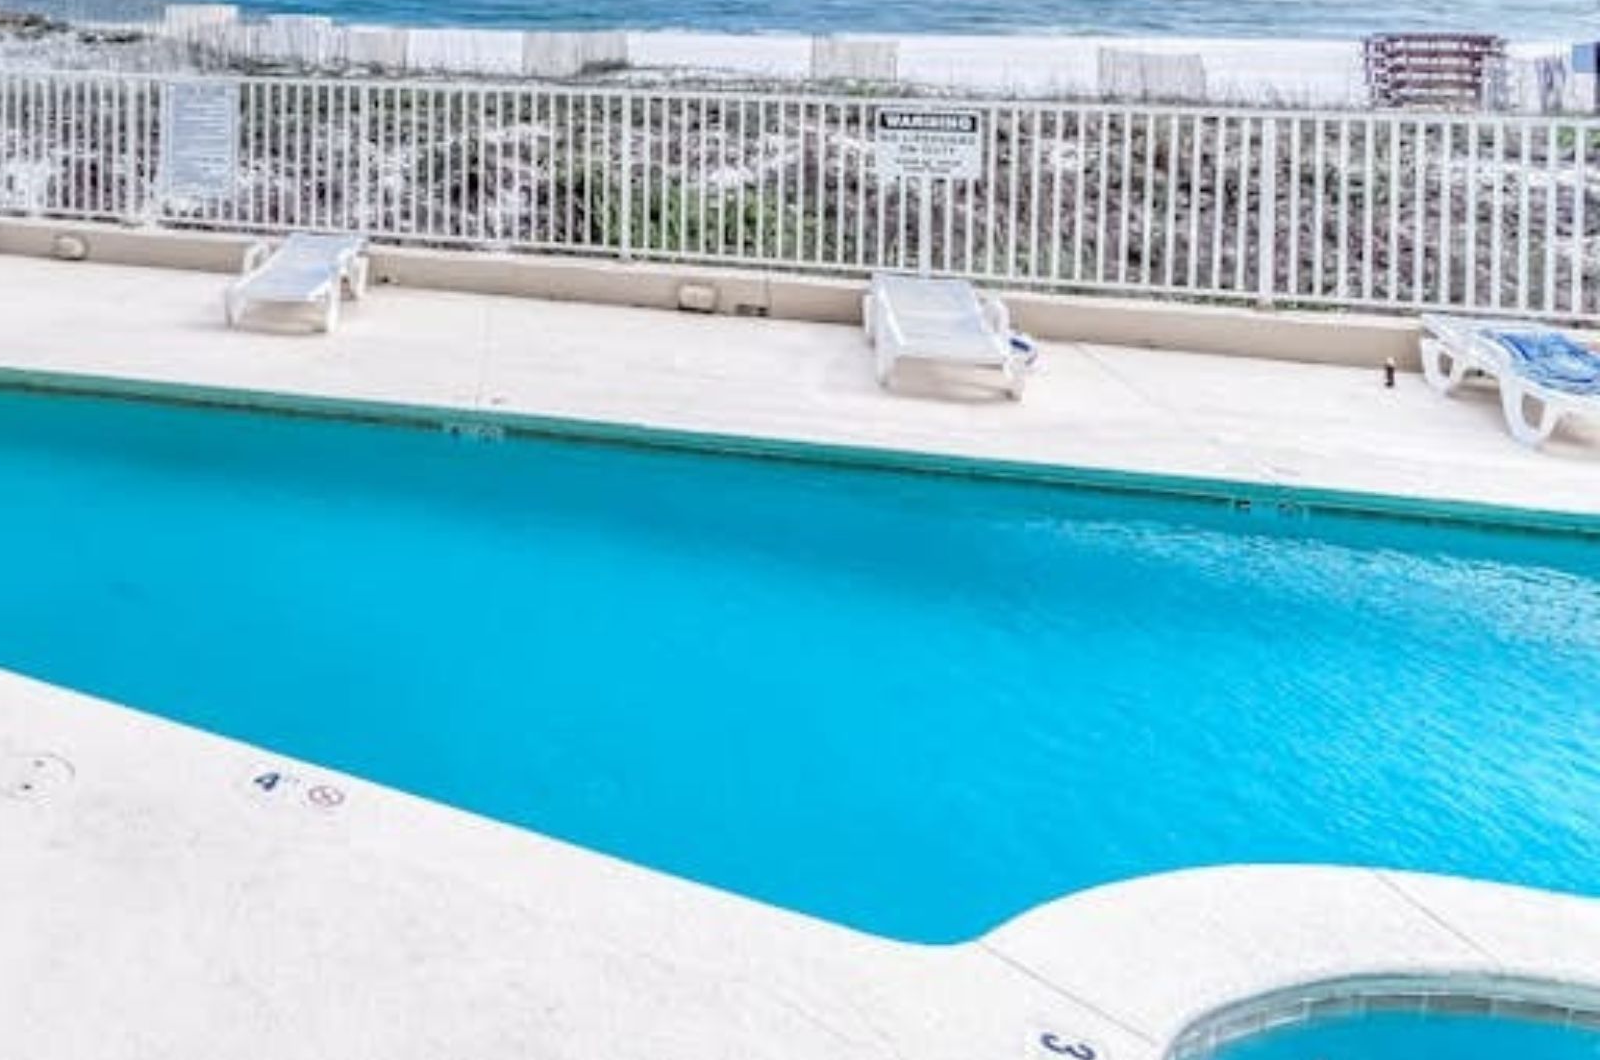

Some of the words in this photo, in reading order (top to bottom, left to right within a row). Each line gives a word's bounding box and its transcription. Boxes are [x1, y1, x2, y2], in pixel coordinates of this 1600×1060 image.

[885, 114, 974, 130] WARNING
[253, 772, 280, 791] 4
[1040, 1033, 1096, 1060] 3
